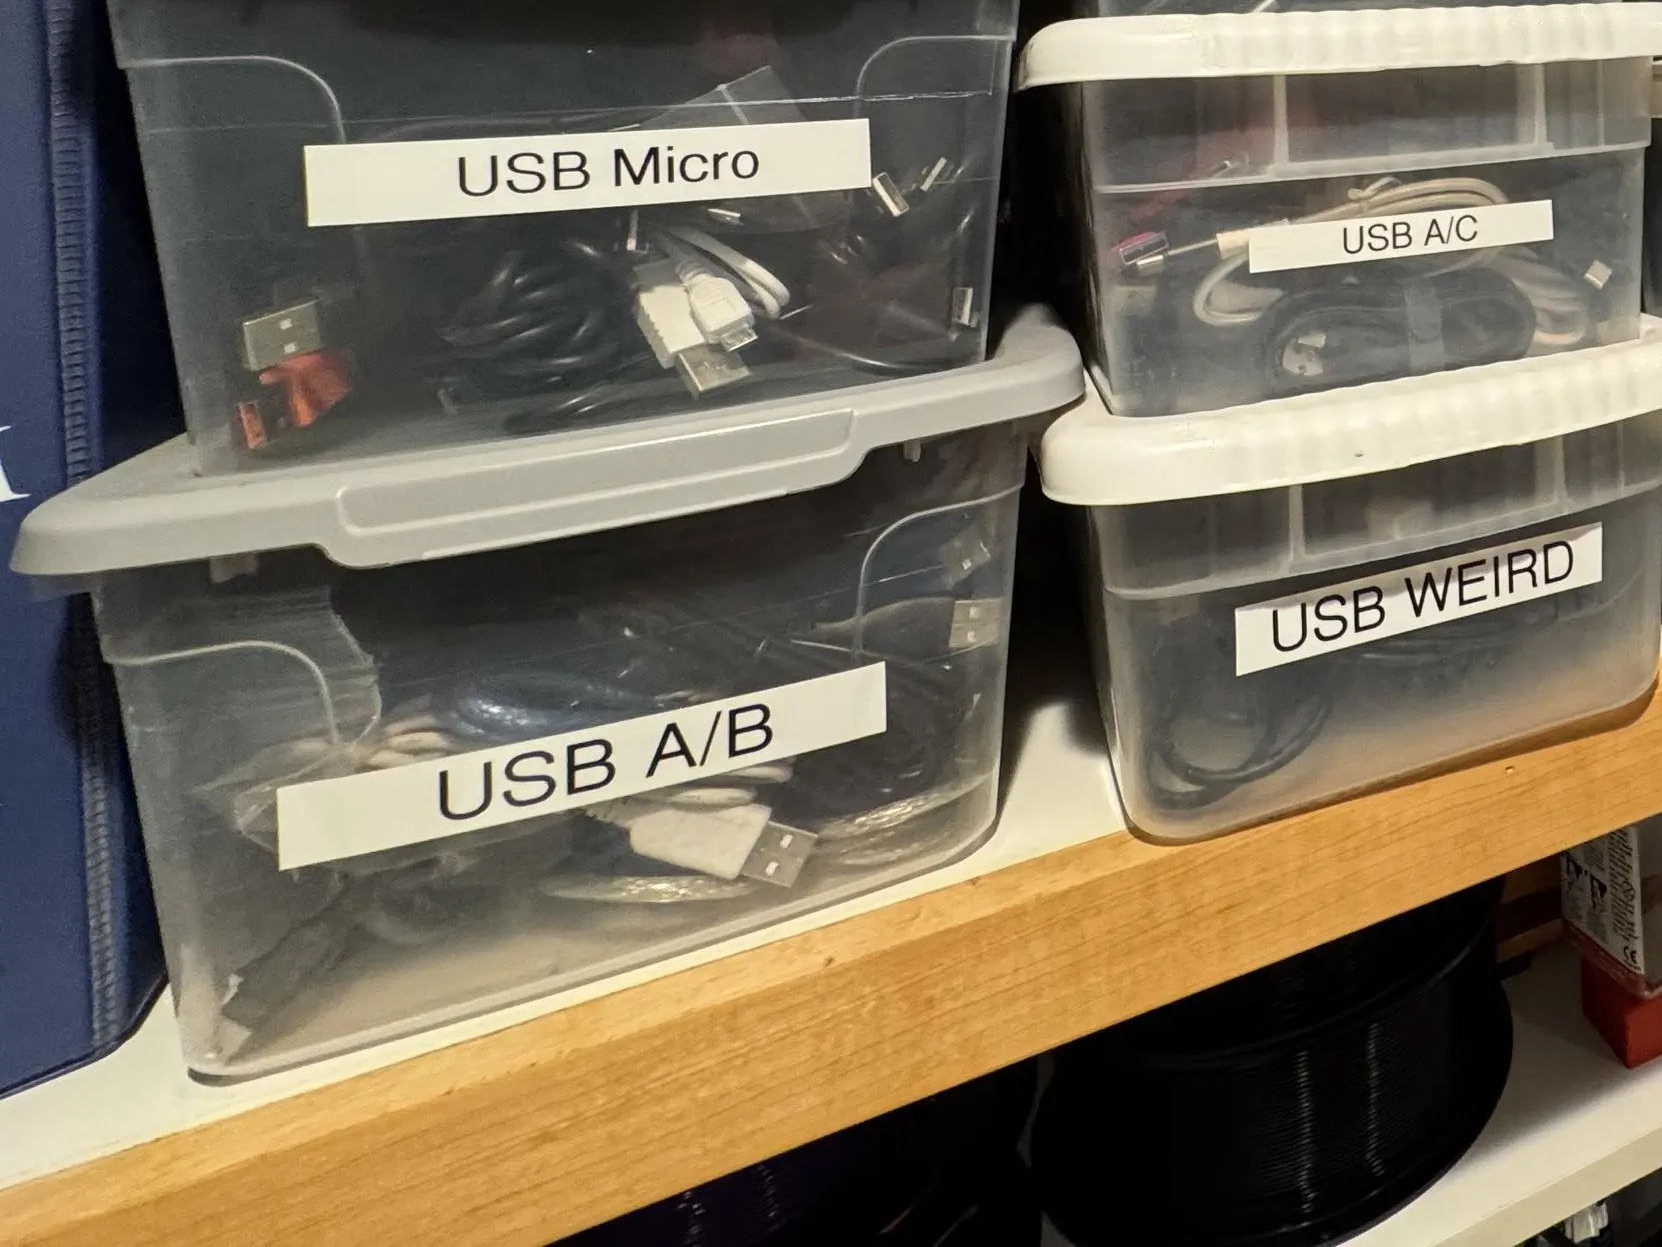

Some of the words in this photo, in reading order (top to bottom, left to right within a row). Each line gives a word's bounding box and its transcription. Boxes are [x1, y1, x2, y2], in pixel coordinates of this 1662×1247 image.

[458, 151, 590, 197] USB
[614, 144, 760, 188] Micro
[1343, 221, 1414, 254] USB
[1424, 213, 1478, 246] A/C
[1271, 585, 1385, 652] USB
[1404, 540, 1574, 618] WEIRD
[439, 738, 615, 821] USB
[645, 702, 774, 778] A/B
